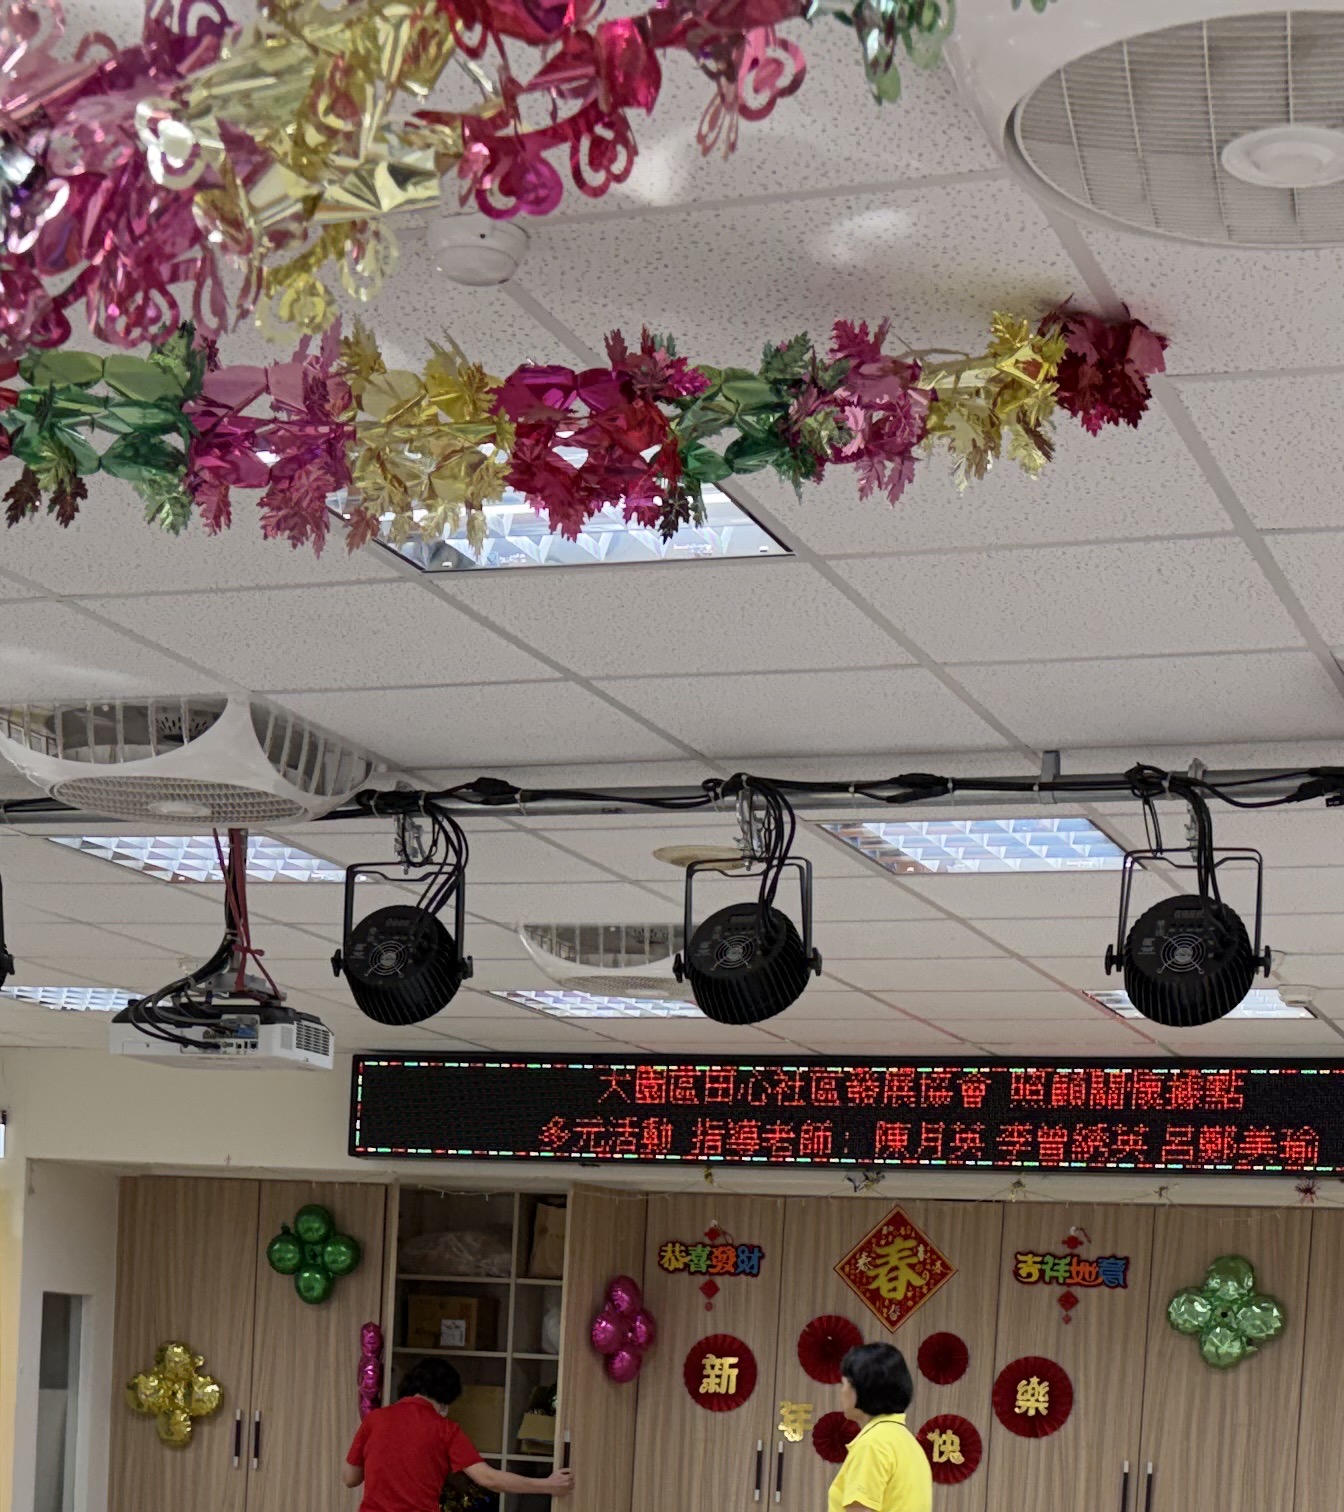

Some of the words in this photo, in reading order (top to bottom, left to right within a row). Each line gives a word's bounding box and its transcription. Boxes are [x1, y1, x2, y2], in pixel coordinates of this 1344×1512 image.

[659, 1242, 763, 1275] 恭喜發財
[865, 1237, 928, 1300] 春
[1015, 1253, 1128, 1287] 吉祥如意
[699, 1353, 739, 1394] 新
[926, 1428, 965, 1465] 快
[1014, 1375, 1049, 1417] 樂
